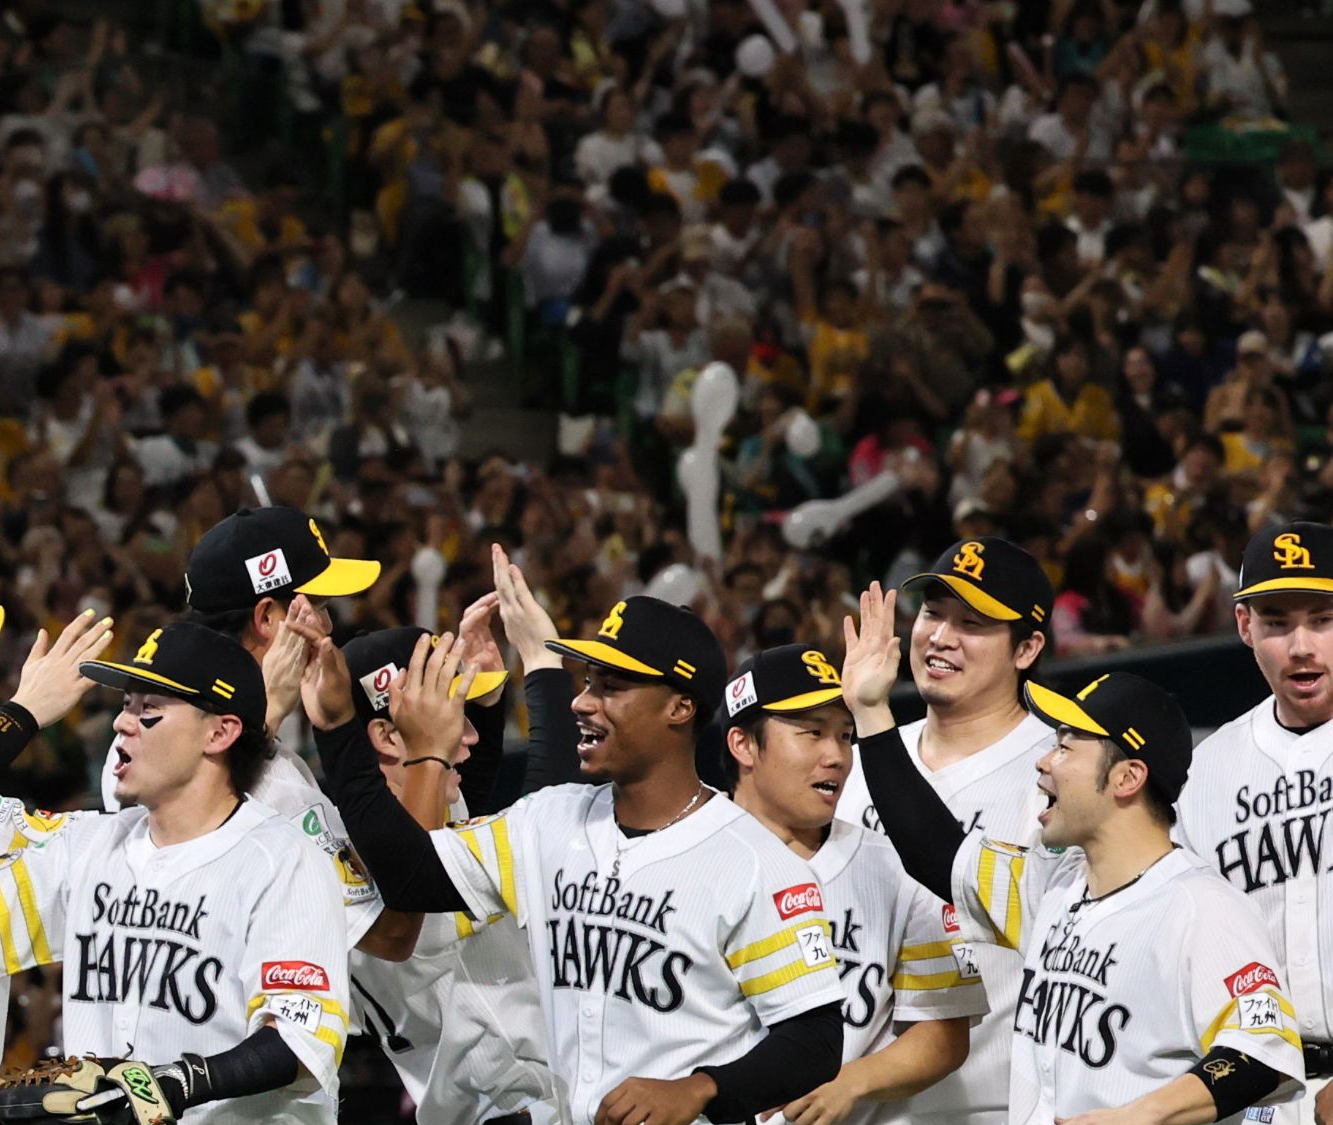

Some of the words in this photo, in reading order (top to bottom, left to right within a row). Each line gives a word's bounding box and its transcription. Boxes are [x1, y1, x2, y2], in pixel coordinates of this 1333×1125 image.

[1215, 807, 1333, 895] HAW
[92, 881, 209, 940] SoftBank
[551, 867, 678, 936] SoftBank
[69, 931, 225, 1026] HAWKS
